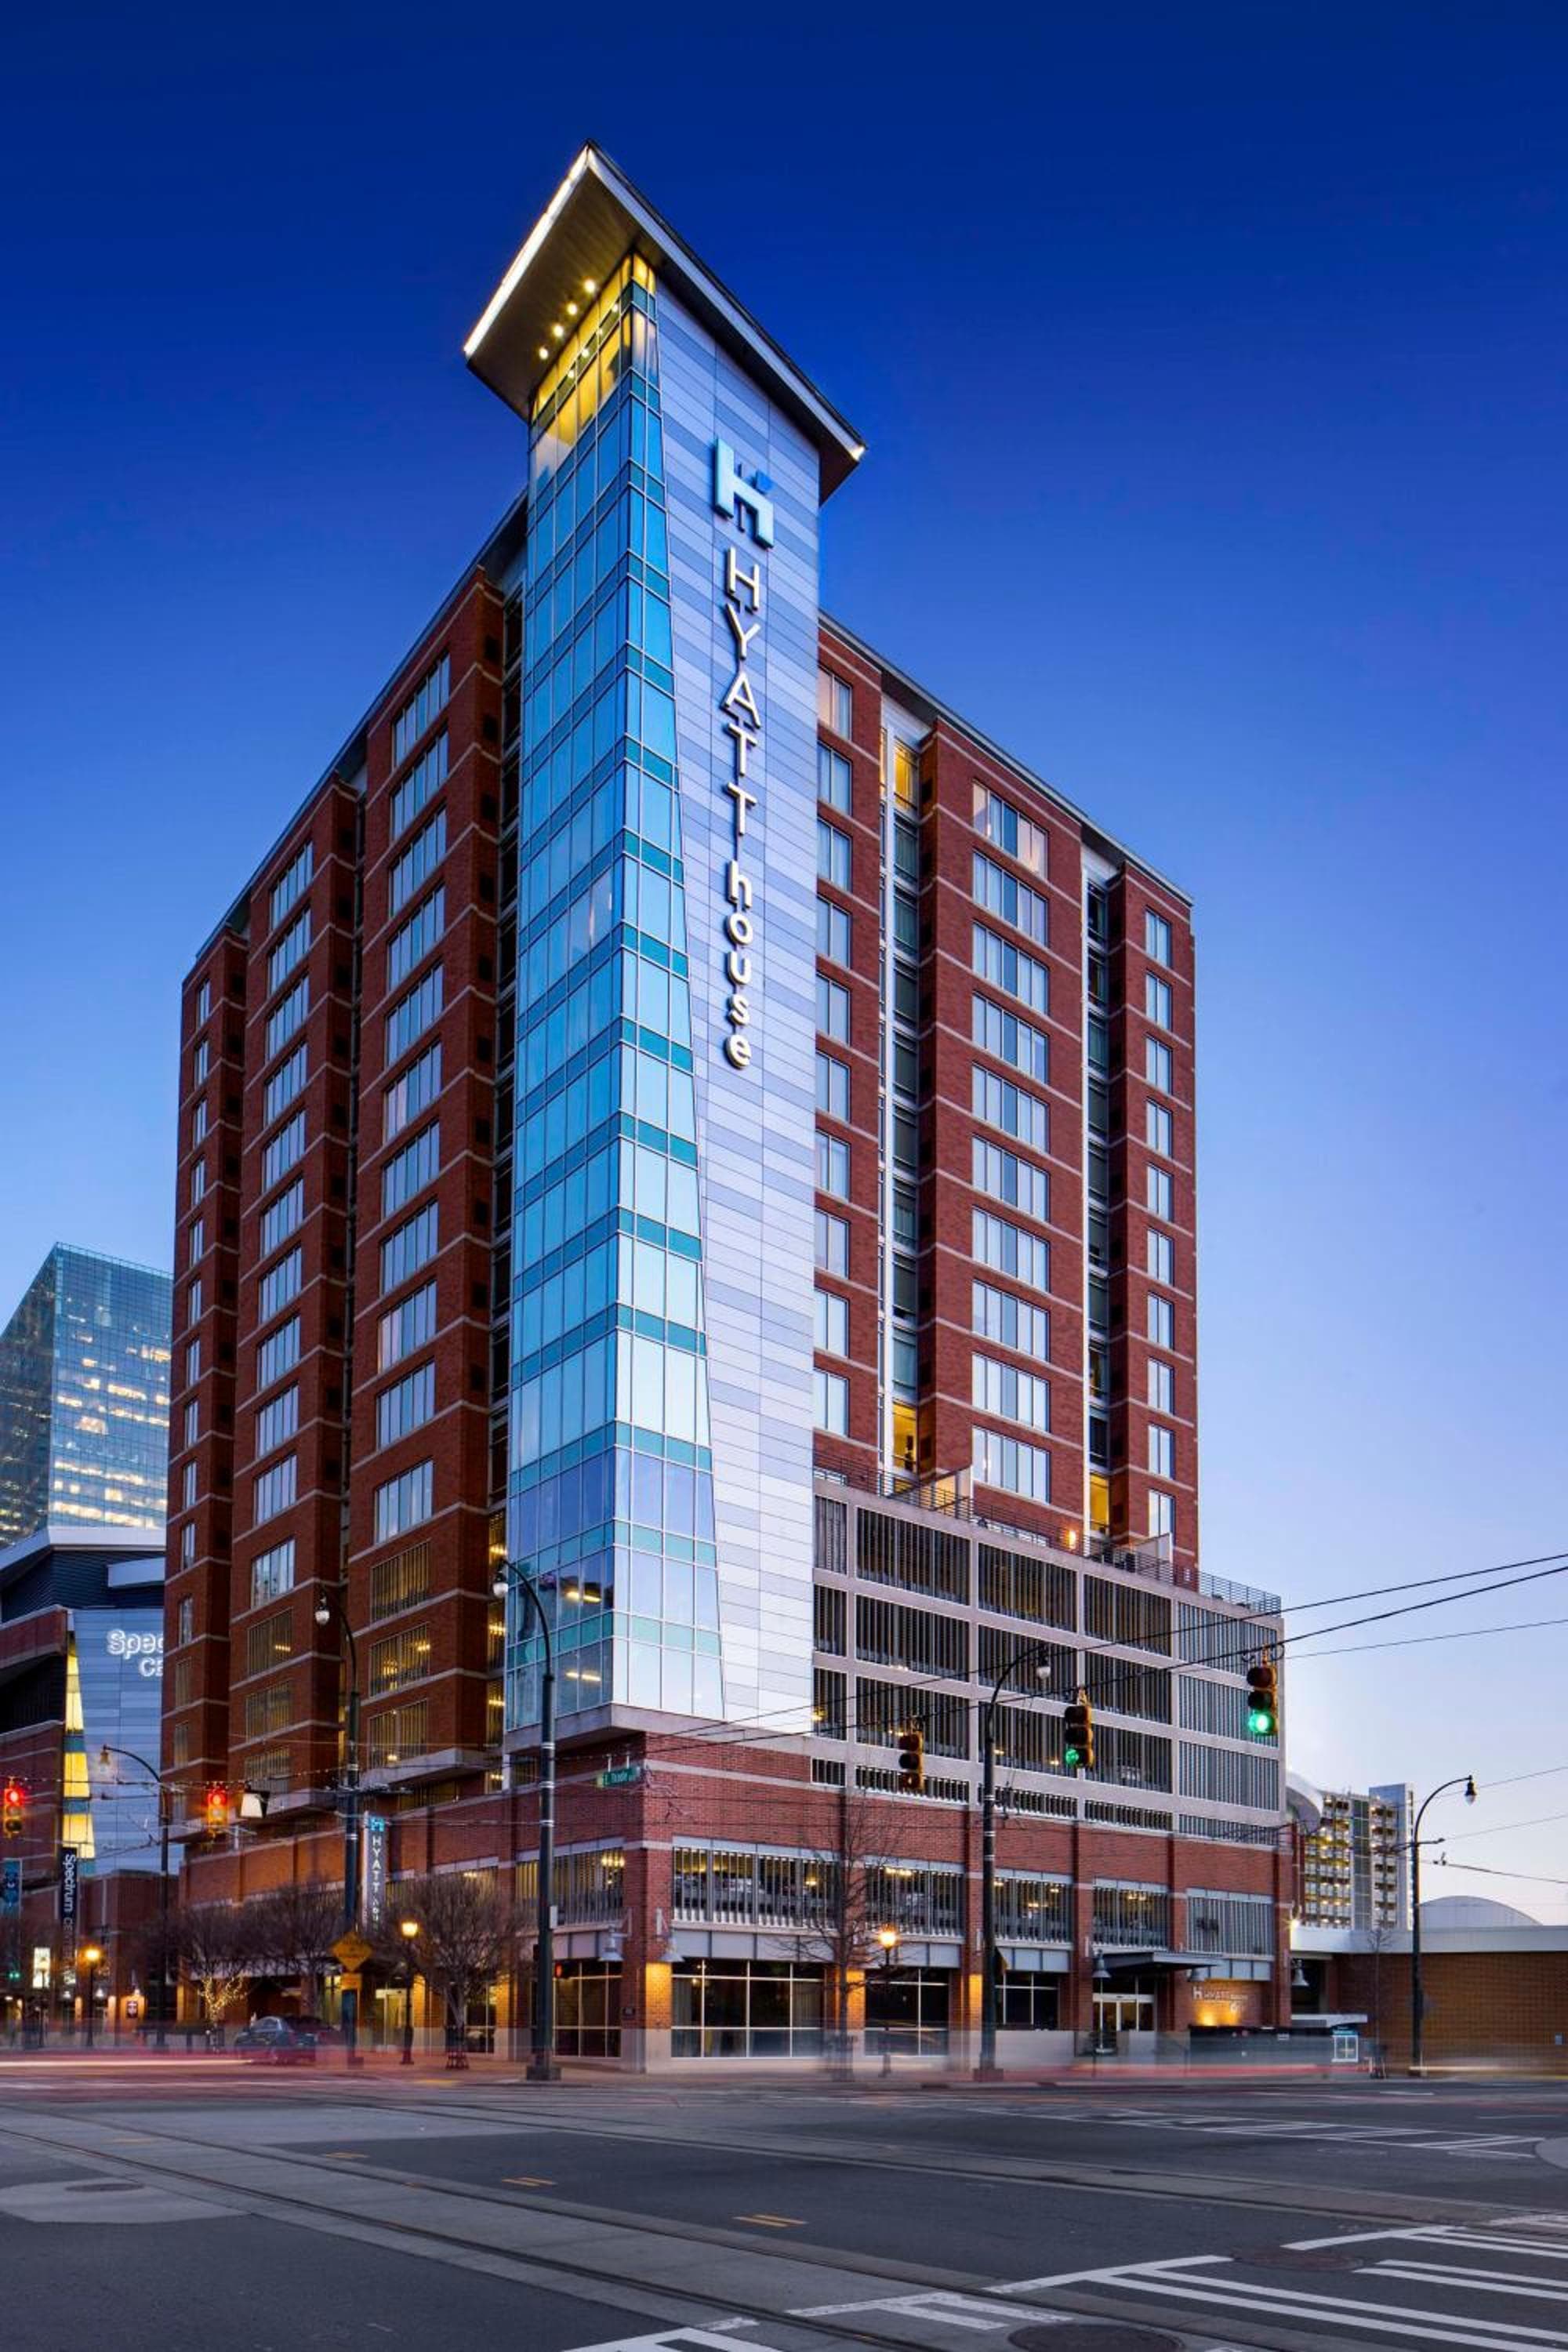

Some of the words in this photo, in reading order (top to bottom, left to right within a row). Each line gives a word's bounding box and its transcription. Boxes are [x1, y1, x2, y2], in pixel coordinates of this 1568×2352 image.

[723, 546, 761, 837] HYATT
[726, 859, 753, 1069] house
[62, 1853, 77, 1912] Spectrum
[372, 1835, 382, 1893] HYATT
